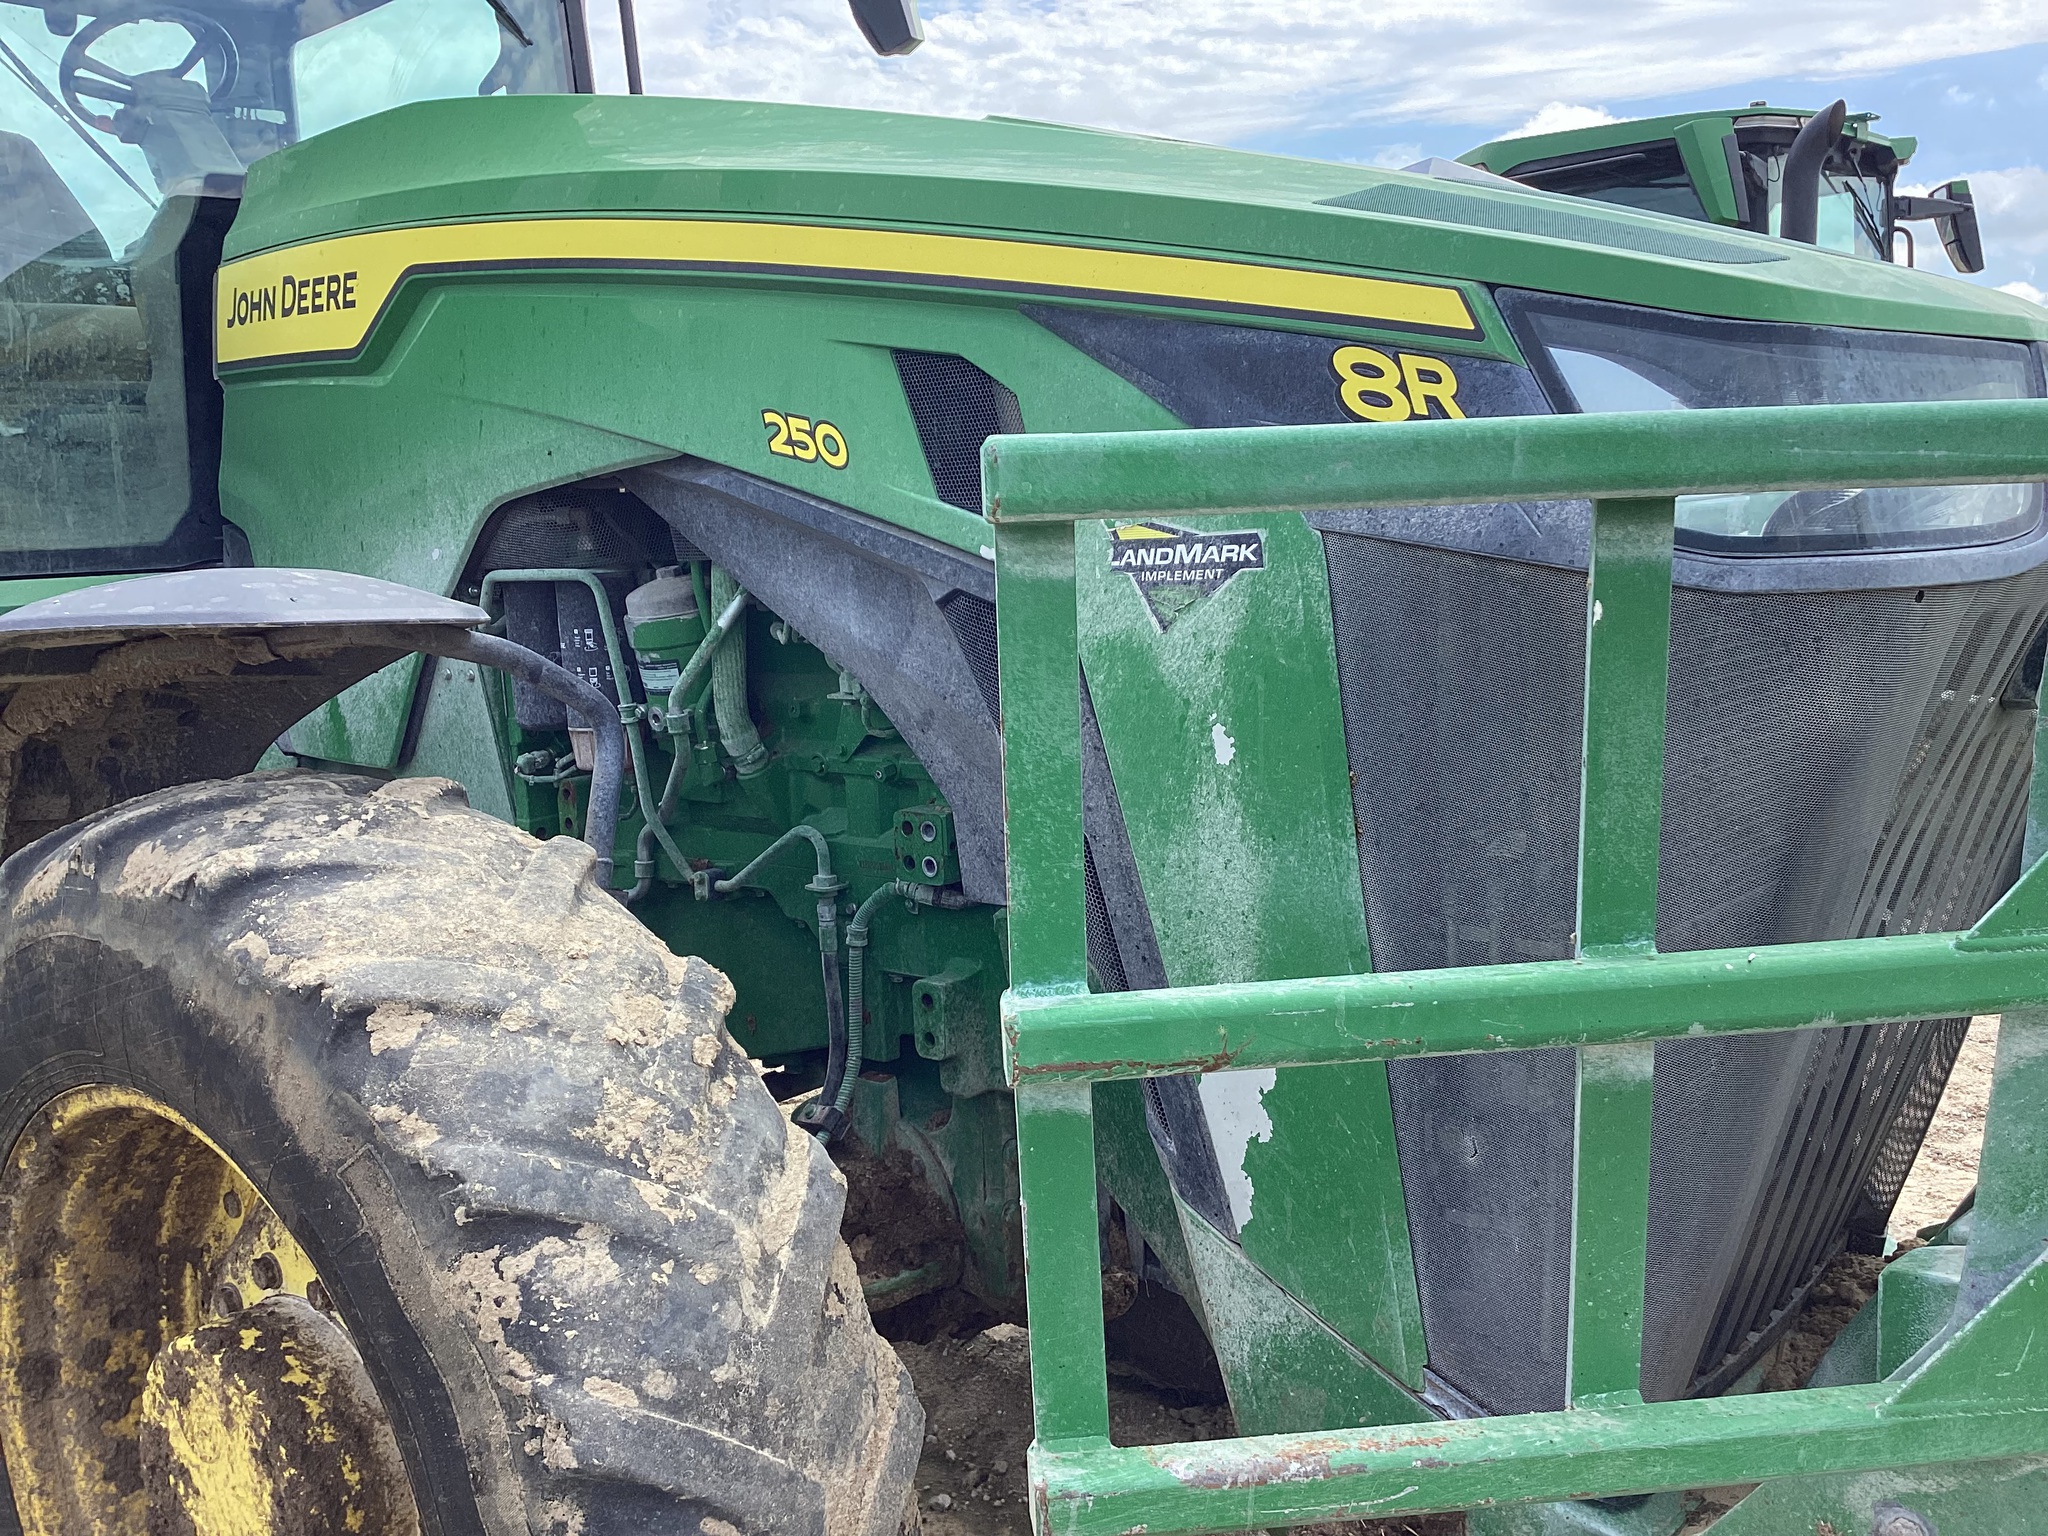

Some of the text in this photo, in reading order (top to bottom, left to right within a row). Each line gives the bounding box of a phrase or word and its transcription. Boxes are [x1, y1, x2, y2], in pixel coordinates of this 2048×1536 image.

[226, 271, 357, 328] JOHN DEERE
[1331, 345, 1467, 422] 8R
[762, 409, 849, 469] 250
[1141, 568, 1224, 582] IMPLEMENT
